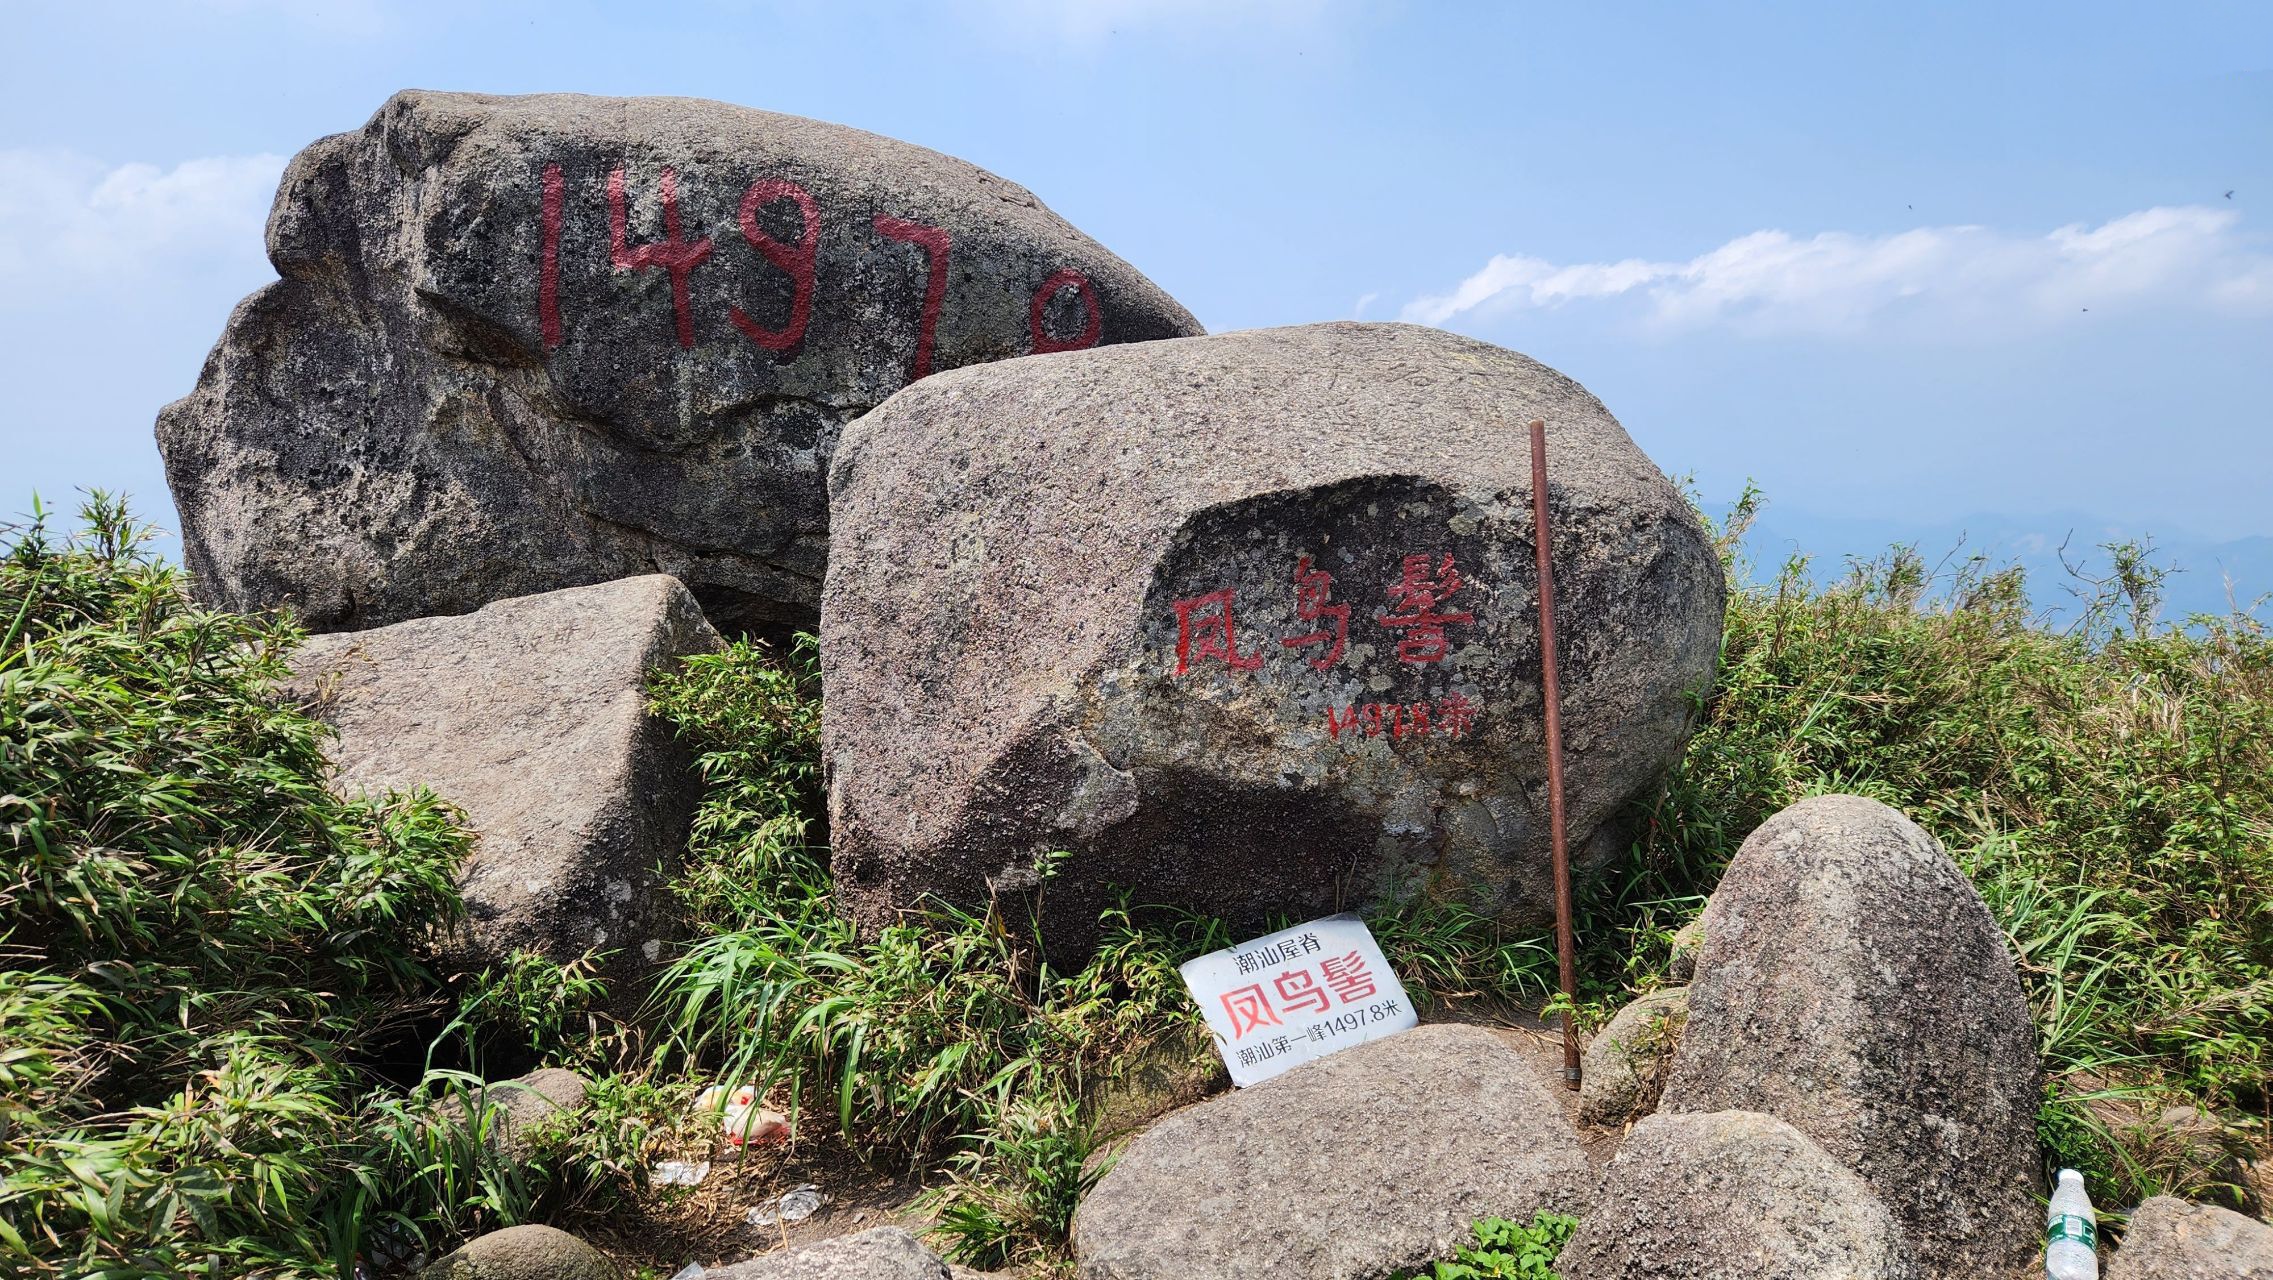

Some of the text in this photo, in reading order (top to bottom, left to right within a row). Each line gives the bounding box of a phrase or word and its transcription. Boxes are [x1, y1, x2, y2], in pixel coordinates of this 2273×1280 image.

[1173, 552, 1475, 678] 凤鸟髻
[1232, 932, 1322, 976] 潮汕屋脊
[1219, 950, 1378, 1041] 凤鸟髻
[1235, 999, 1402, 1069] 潮汕第一峰1497.8米
